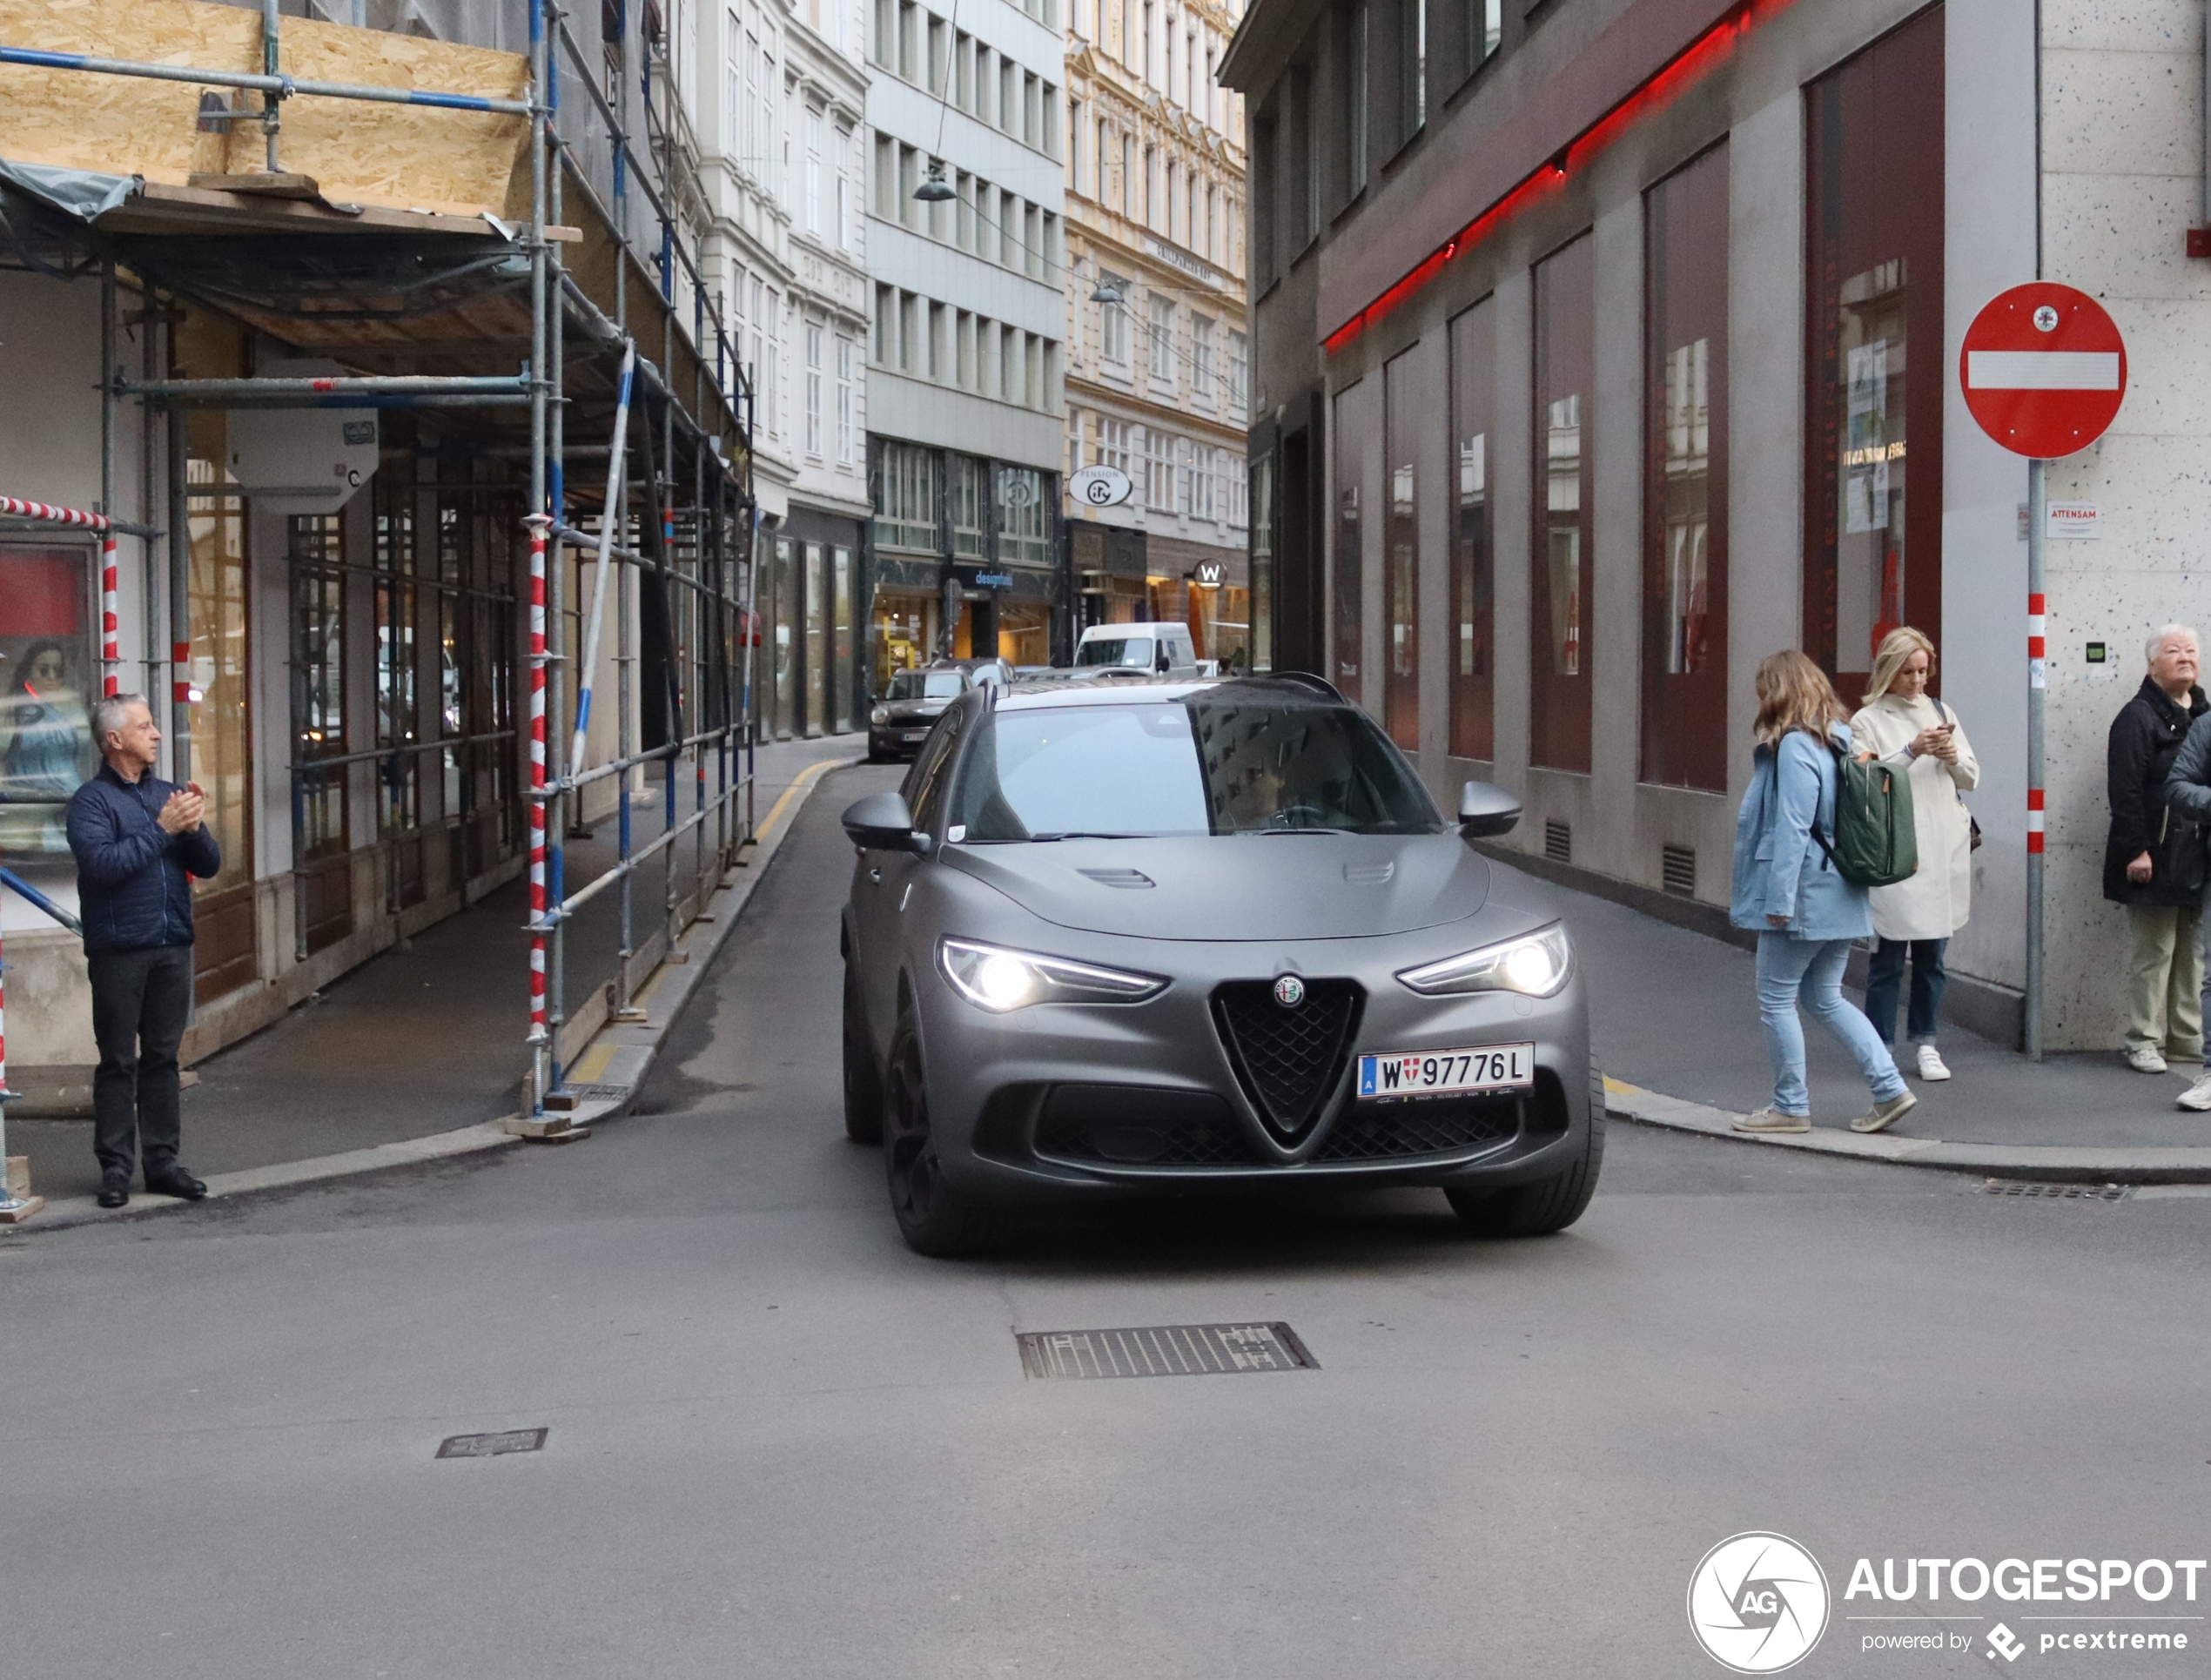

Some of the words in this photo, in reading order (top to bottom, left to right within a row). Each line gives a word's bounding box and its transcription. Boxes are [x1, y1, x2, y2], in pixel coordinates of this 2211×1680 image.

[1080, 470, 1119, 479] PENSION
[2052, 509, 2097, 520] ATTENSAM
[1201, 564, 1220, 581] W
[1365, 1081, 1373, 1090] A
